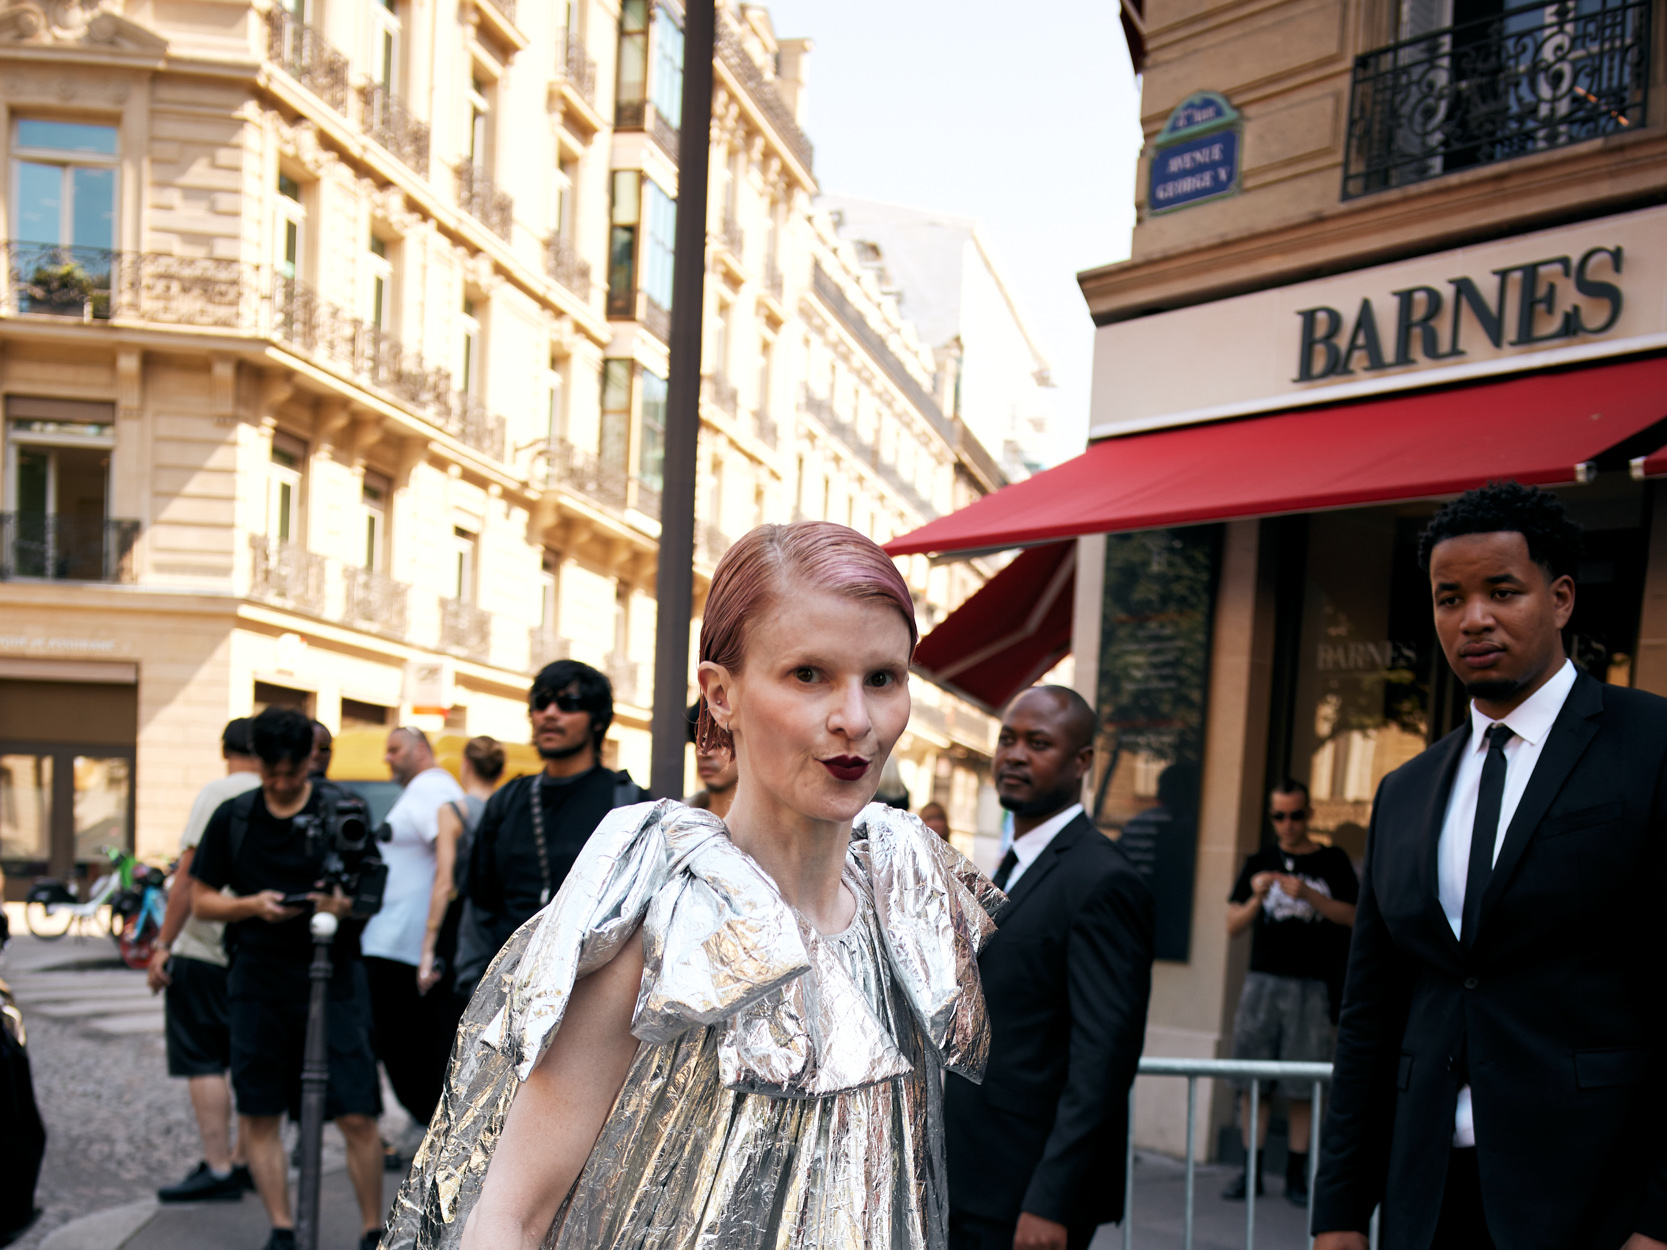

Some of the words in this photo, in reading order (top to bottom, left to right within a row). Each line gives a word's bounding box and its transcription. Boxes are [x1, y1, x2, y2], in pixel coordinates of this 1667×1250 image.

[1167, 143, 1223, 171] AVENUE
[1156, 171, 1214, 199] GEORGE
[1218, 166, 1230, 182] V
[1291, 245, 1624, 384] BARNES
[1316, 640, 1417, 671] BARNES
